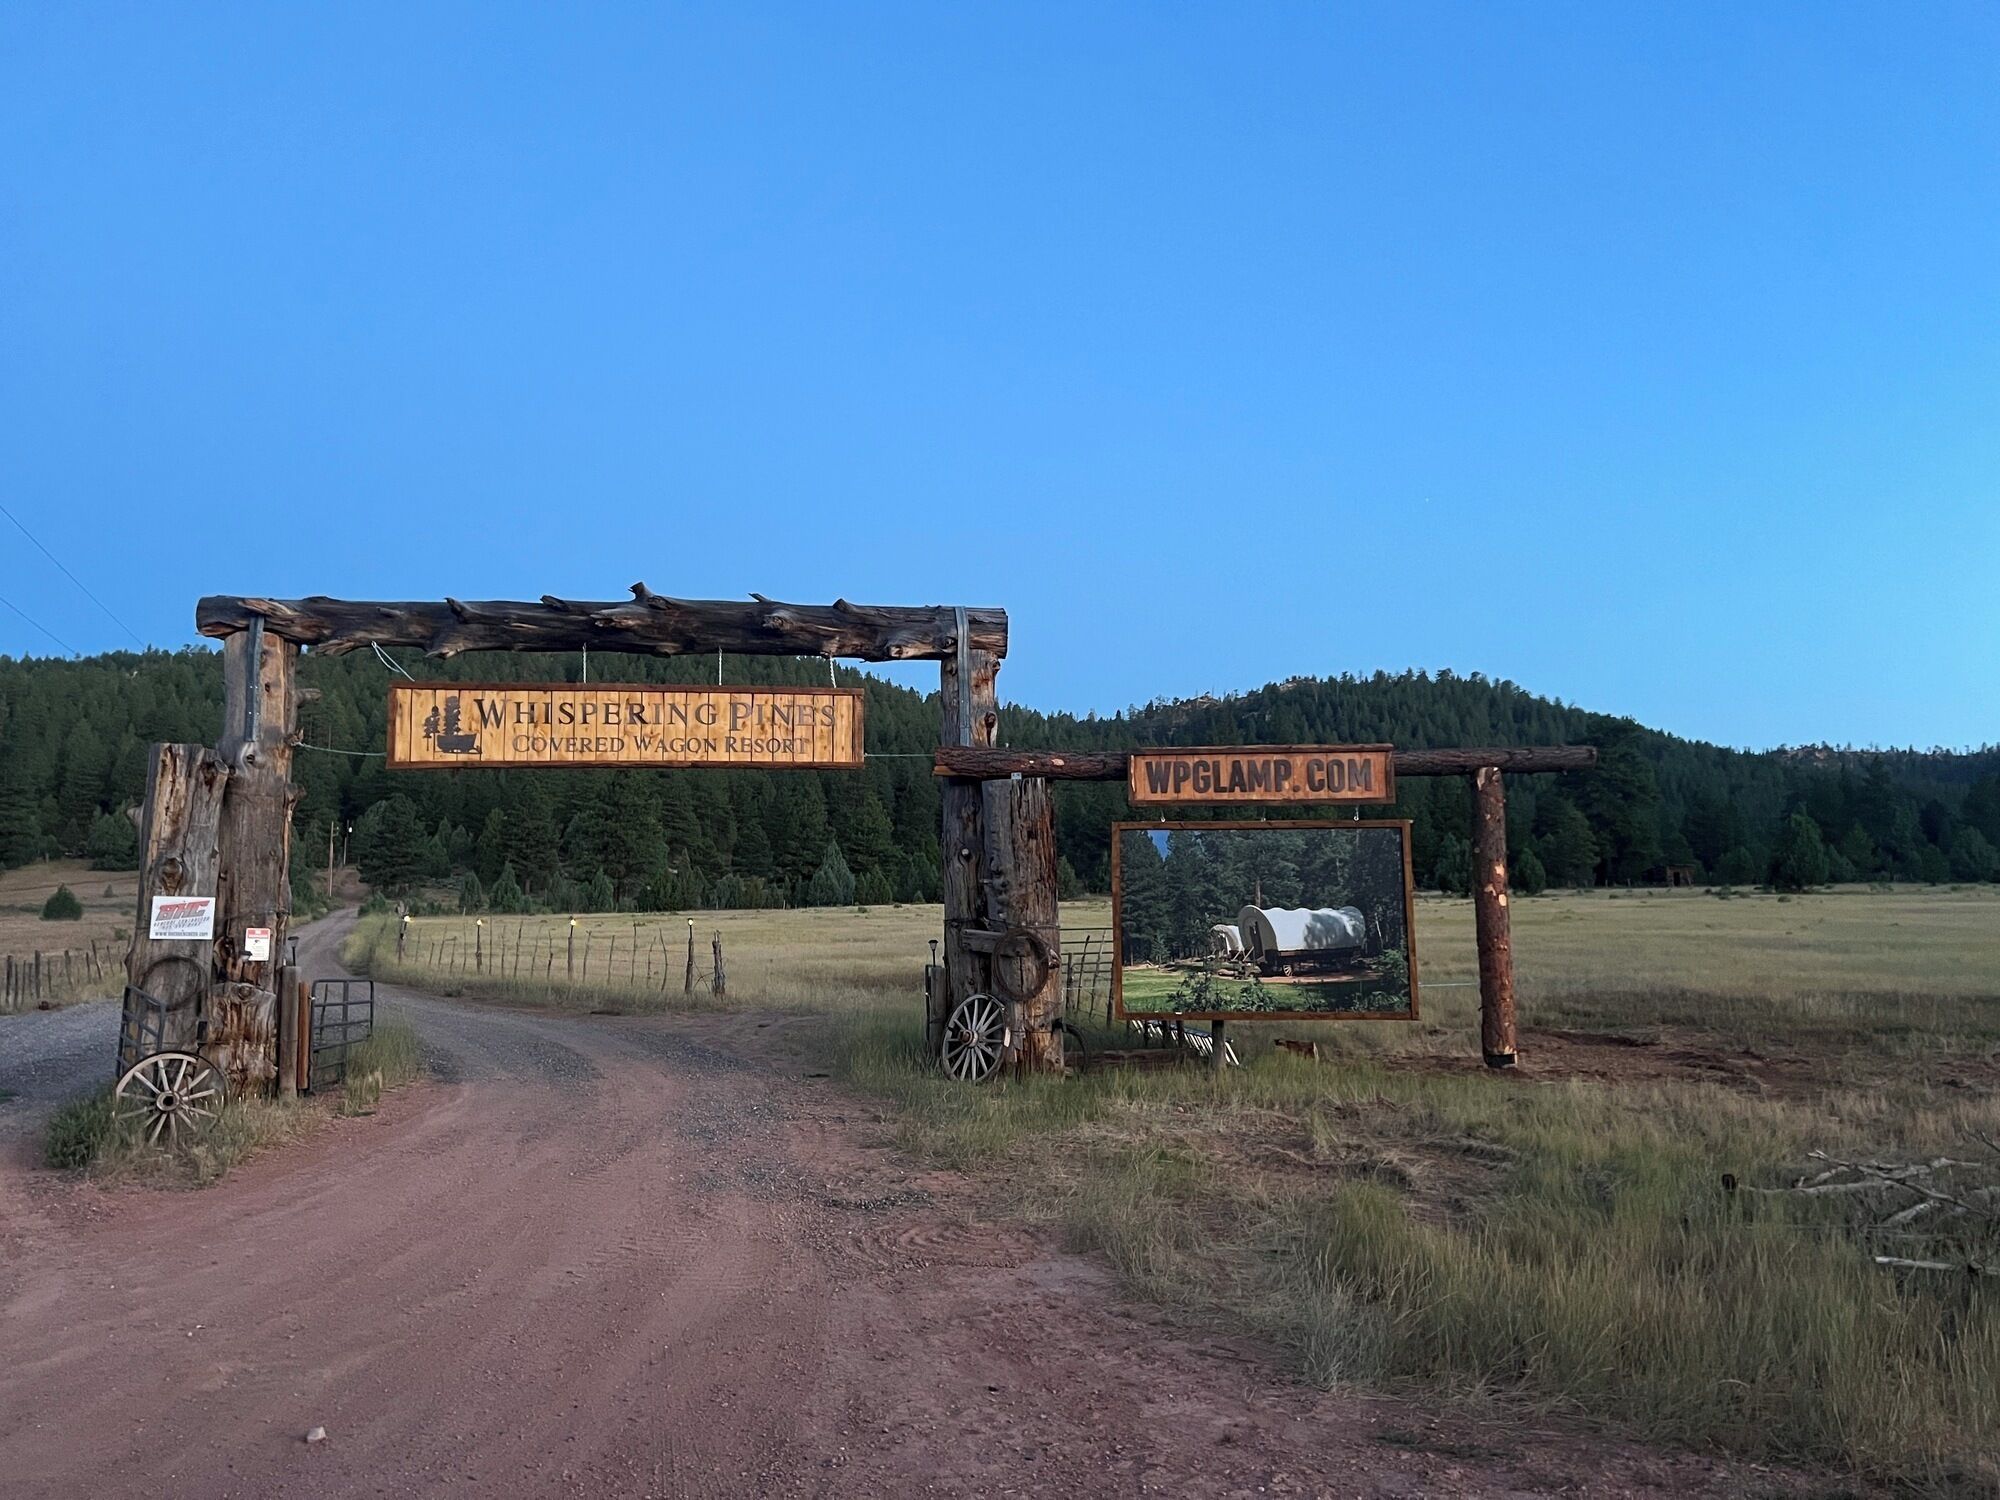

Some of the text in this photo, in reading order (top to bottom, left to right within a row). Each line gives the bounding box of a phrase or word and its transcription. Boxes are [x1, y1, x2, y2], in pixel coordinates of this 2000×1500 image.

[474, 698, 836, 732] WHISPERING PINES
[513, 734, 811, 755] COVERED WAGON RESORT
[1145, 758, 1372, 794] WPGLAMP.COM
[155, 900, 210, 922] BHC
